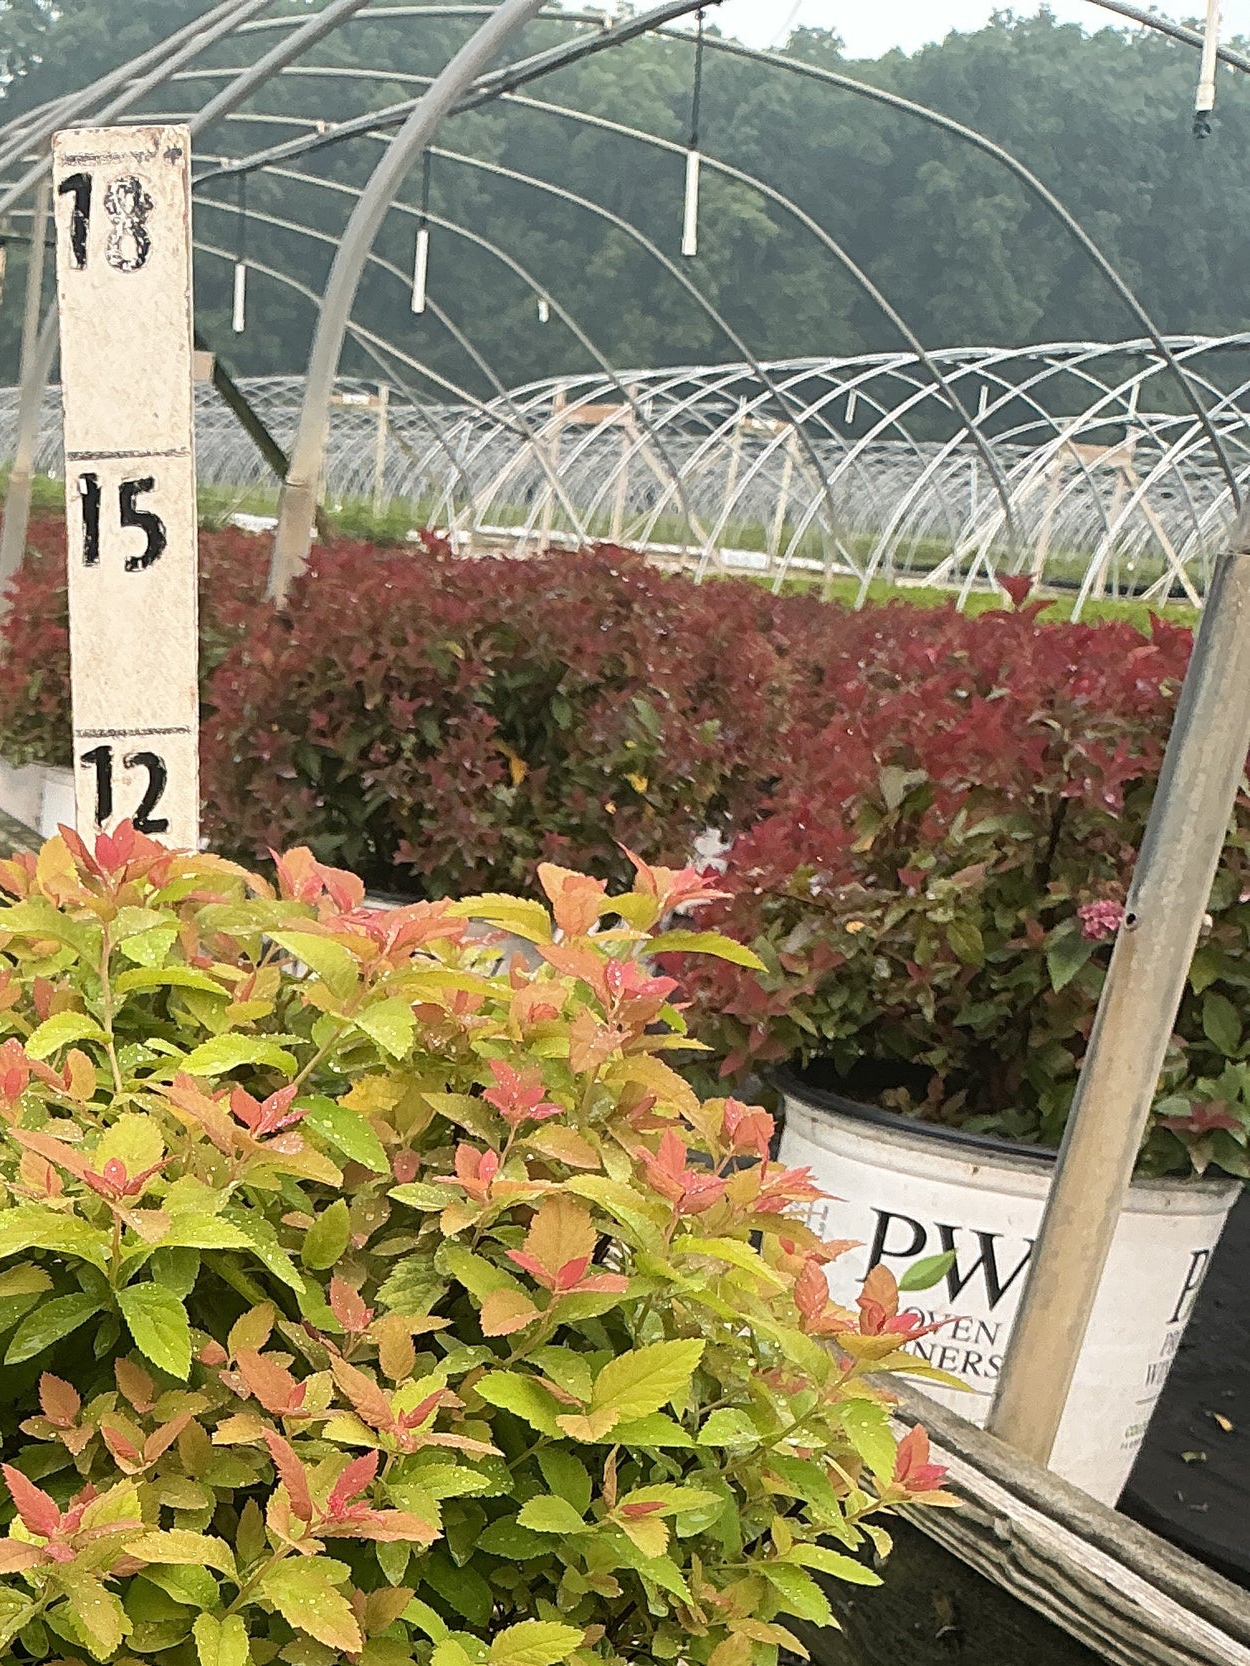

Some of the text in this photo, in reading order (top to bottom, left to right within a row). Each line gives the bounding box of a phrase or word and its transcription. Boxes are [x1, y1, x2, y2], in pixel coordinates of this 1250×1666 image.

[58, 172, 154, 274] 18
[78, 472, 167, 573] 15
[81, 745, 170, 835] 12
[855, 1207, 1035, 1312] PW
